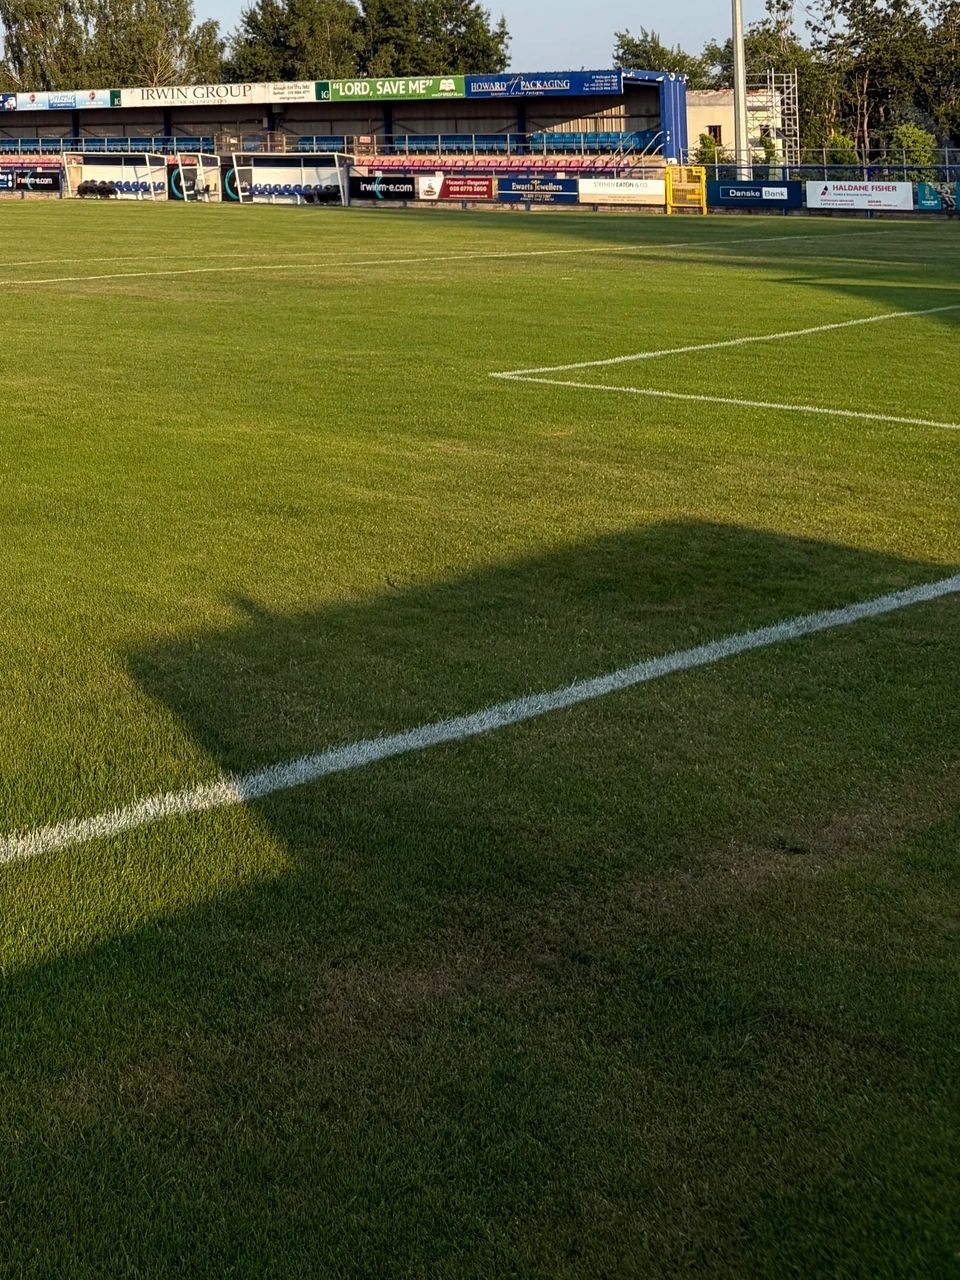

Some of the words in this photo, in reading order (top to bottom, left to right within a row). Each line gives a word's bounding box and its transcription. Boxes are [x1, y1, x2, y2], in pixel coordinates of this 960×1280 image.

[376, 80, 406, 95] SAVE
[408, 79, 433, 94] ME”
[471, 81, 507, 92] HOWARD
[520, 79, 570, 91] PACKAGING
[141, 87, 188, 101] IRWIN
[193, 85, 252, 99] GROUP
[321, 90, 329, 99] IG
[729, 189, 761, 198] Danske
[764, 190, 785, 198] Bank
[832, 184, 869, 192] HALDANE
